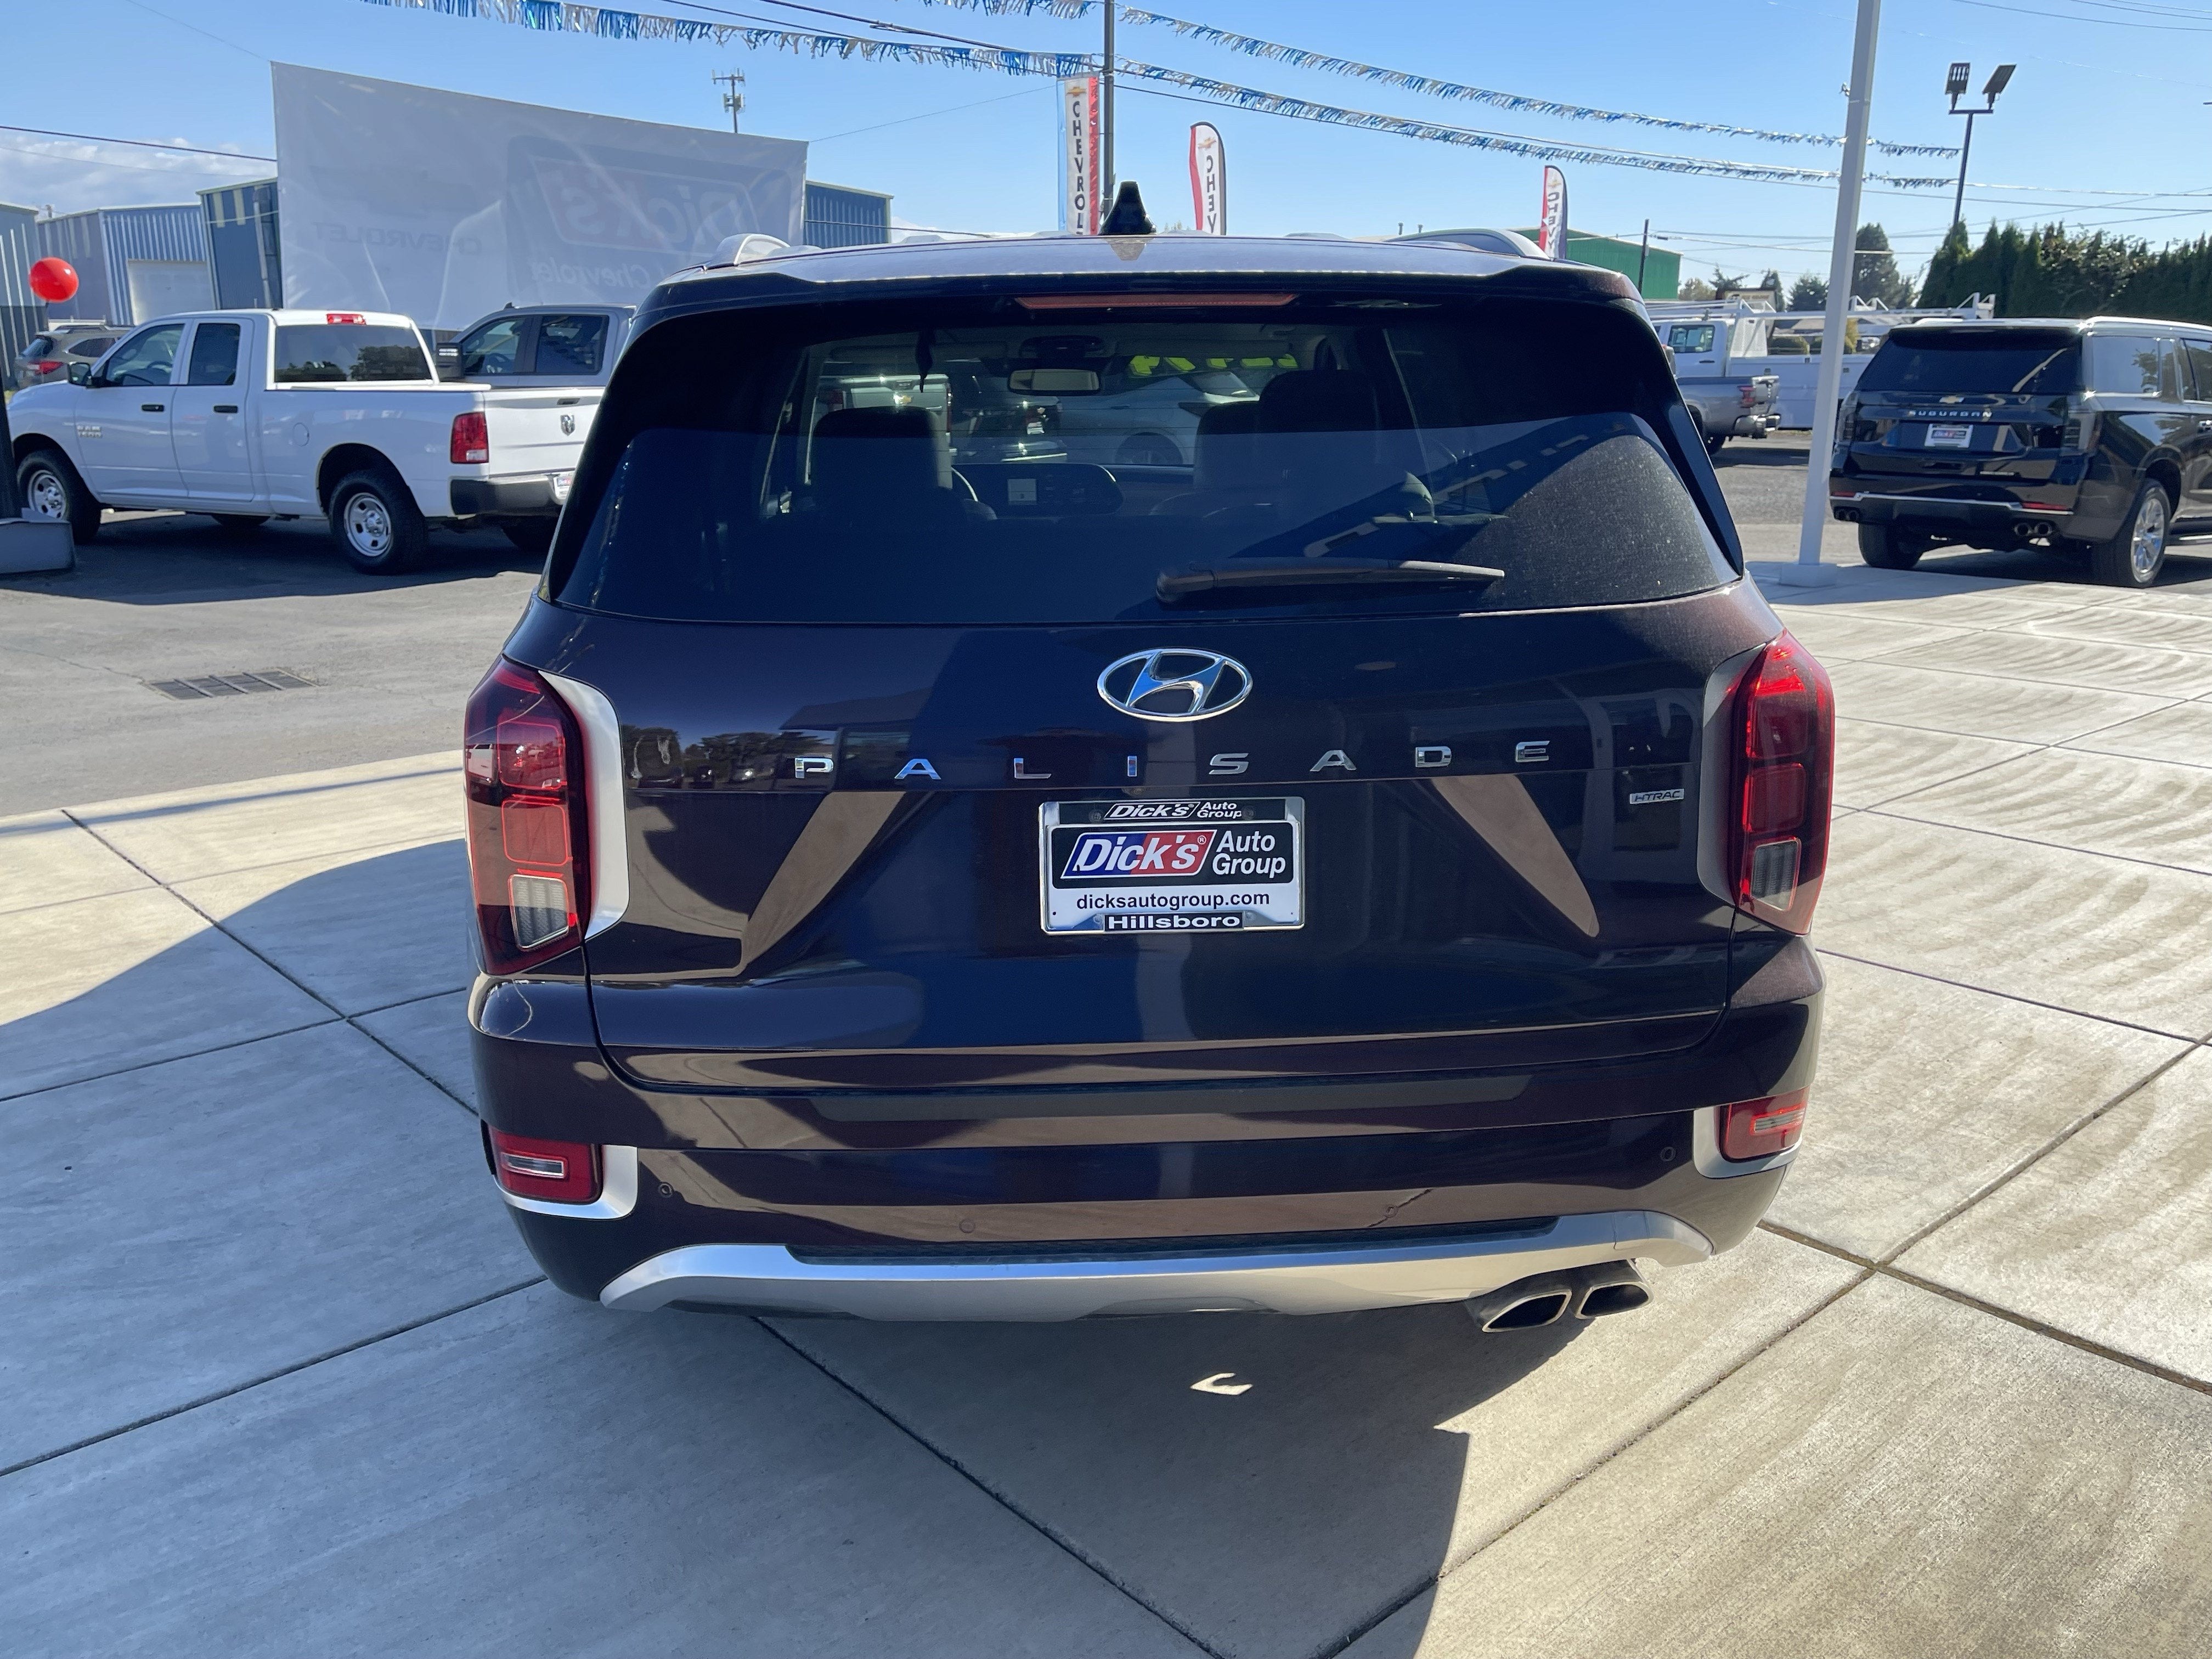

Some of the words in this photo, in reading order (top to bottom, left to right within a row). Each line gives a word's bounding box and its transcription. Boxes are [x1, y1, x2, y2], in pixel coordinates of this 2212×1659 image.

[794, 740, 1550, 780] PALISADE
[1634, 791, 1680, 802] HTRAC
[1109, 804, 1189, 818] Dick's
[1201, 802, 1237, 810] Auto
[1197, 809, 1243, 819] Group
[1216, 830, 1276, 853] Auto
[1212, 853, 1286, 879] Group
[1076, 893, 1270, 911] dicksautogroup.com
[1108, 915, 1241, 929] Hillsboro
